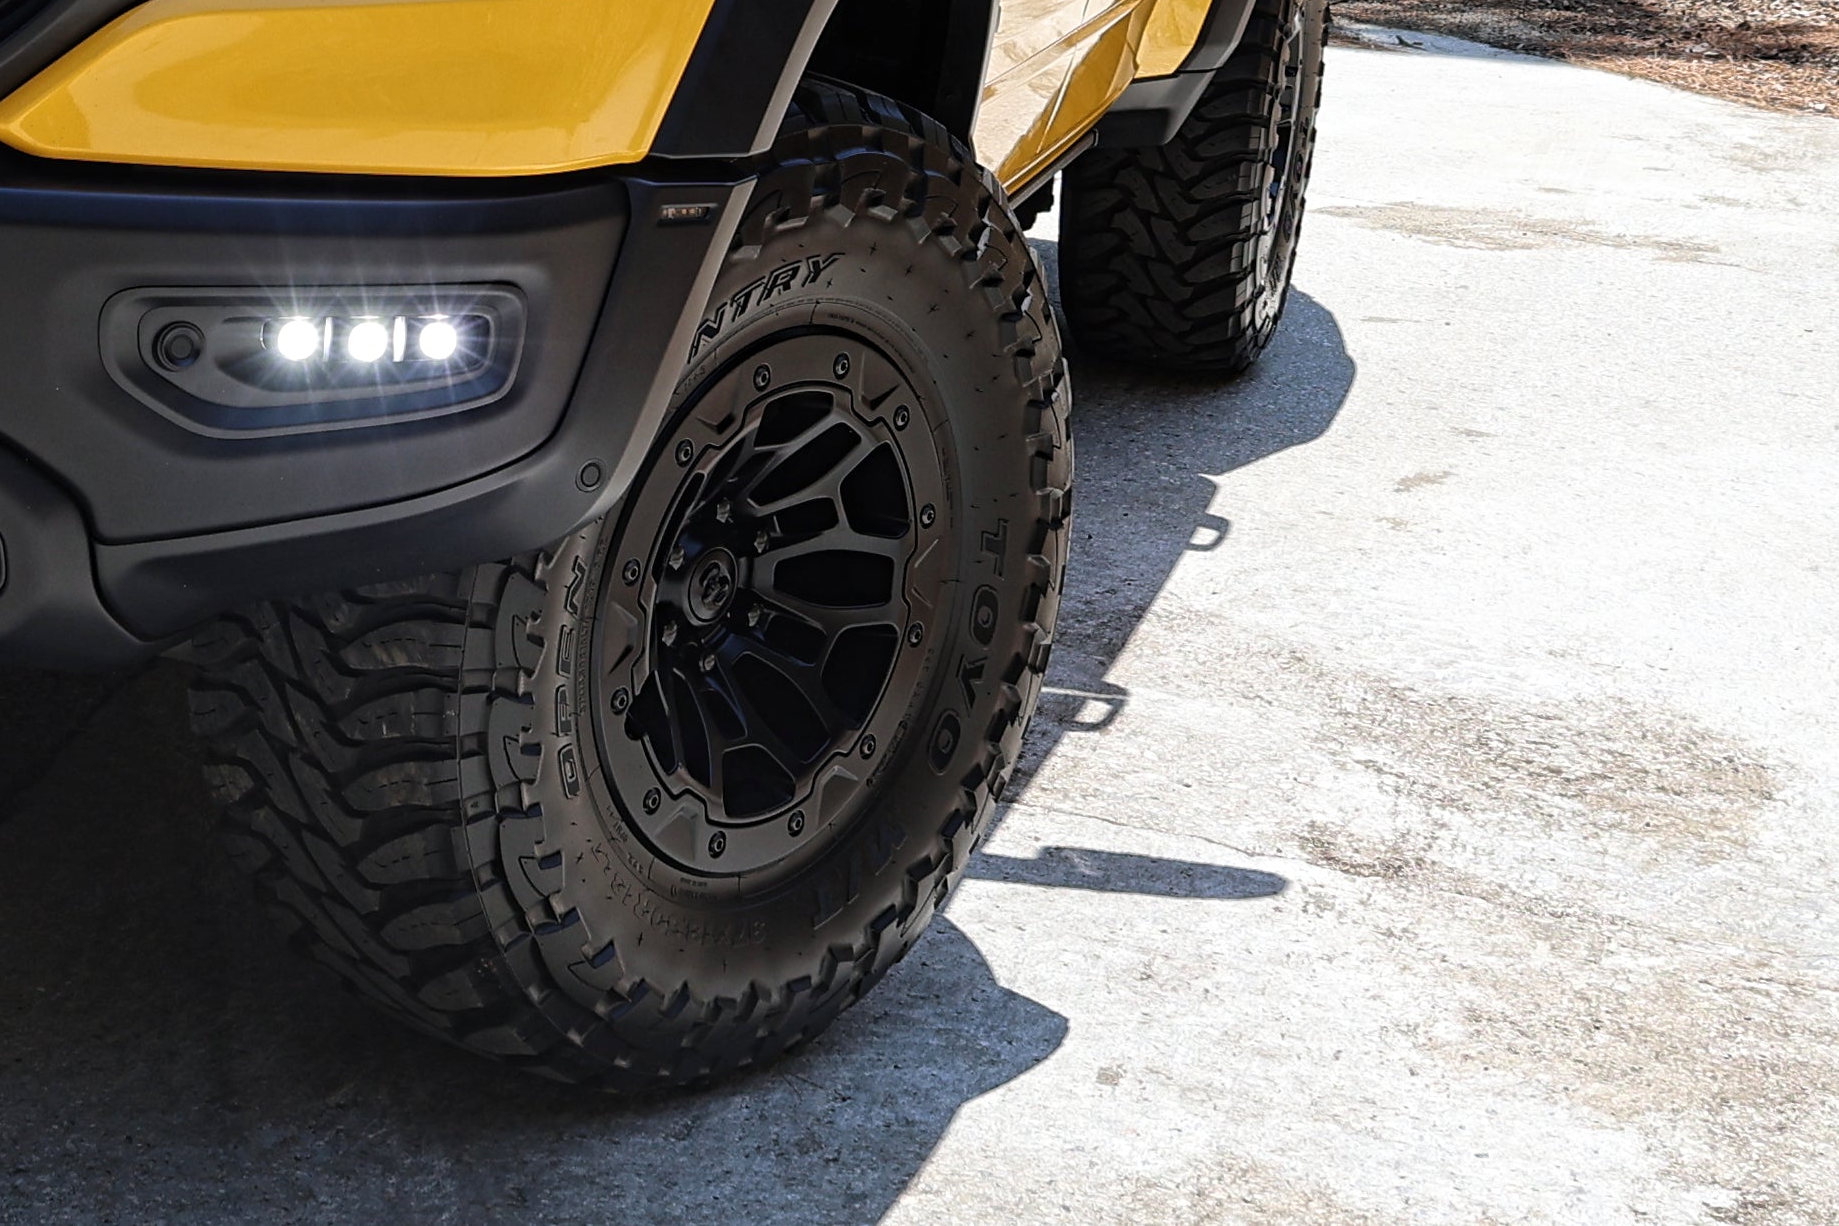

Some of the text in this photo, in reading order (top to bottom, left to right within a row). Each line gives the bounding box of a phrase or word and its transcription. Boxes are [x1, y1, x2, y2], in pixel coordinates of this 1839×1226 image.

[555, 251, 846, 801] OPEN NTRY
[928, 517, 1010, 777] TOYO
